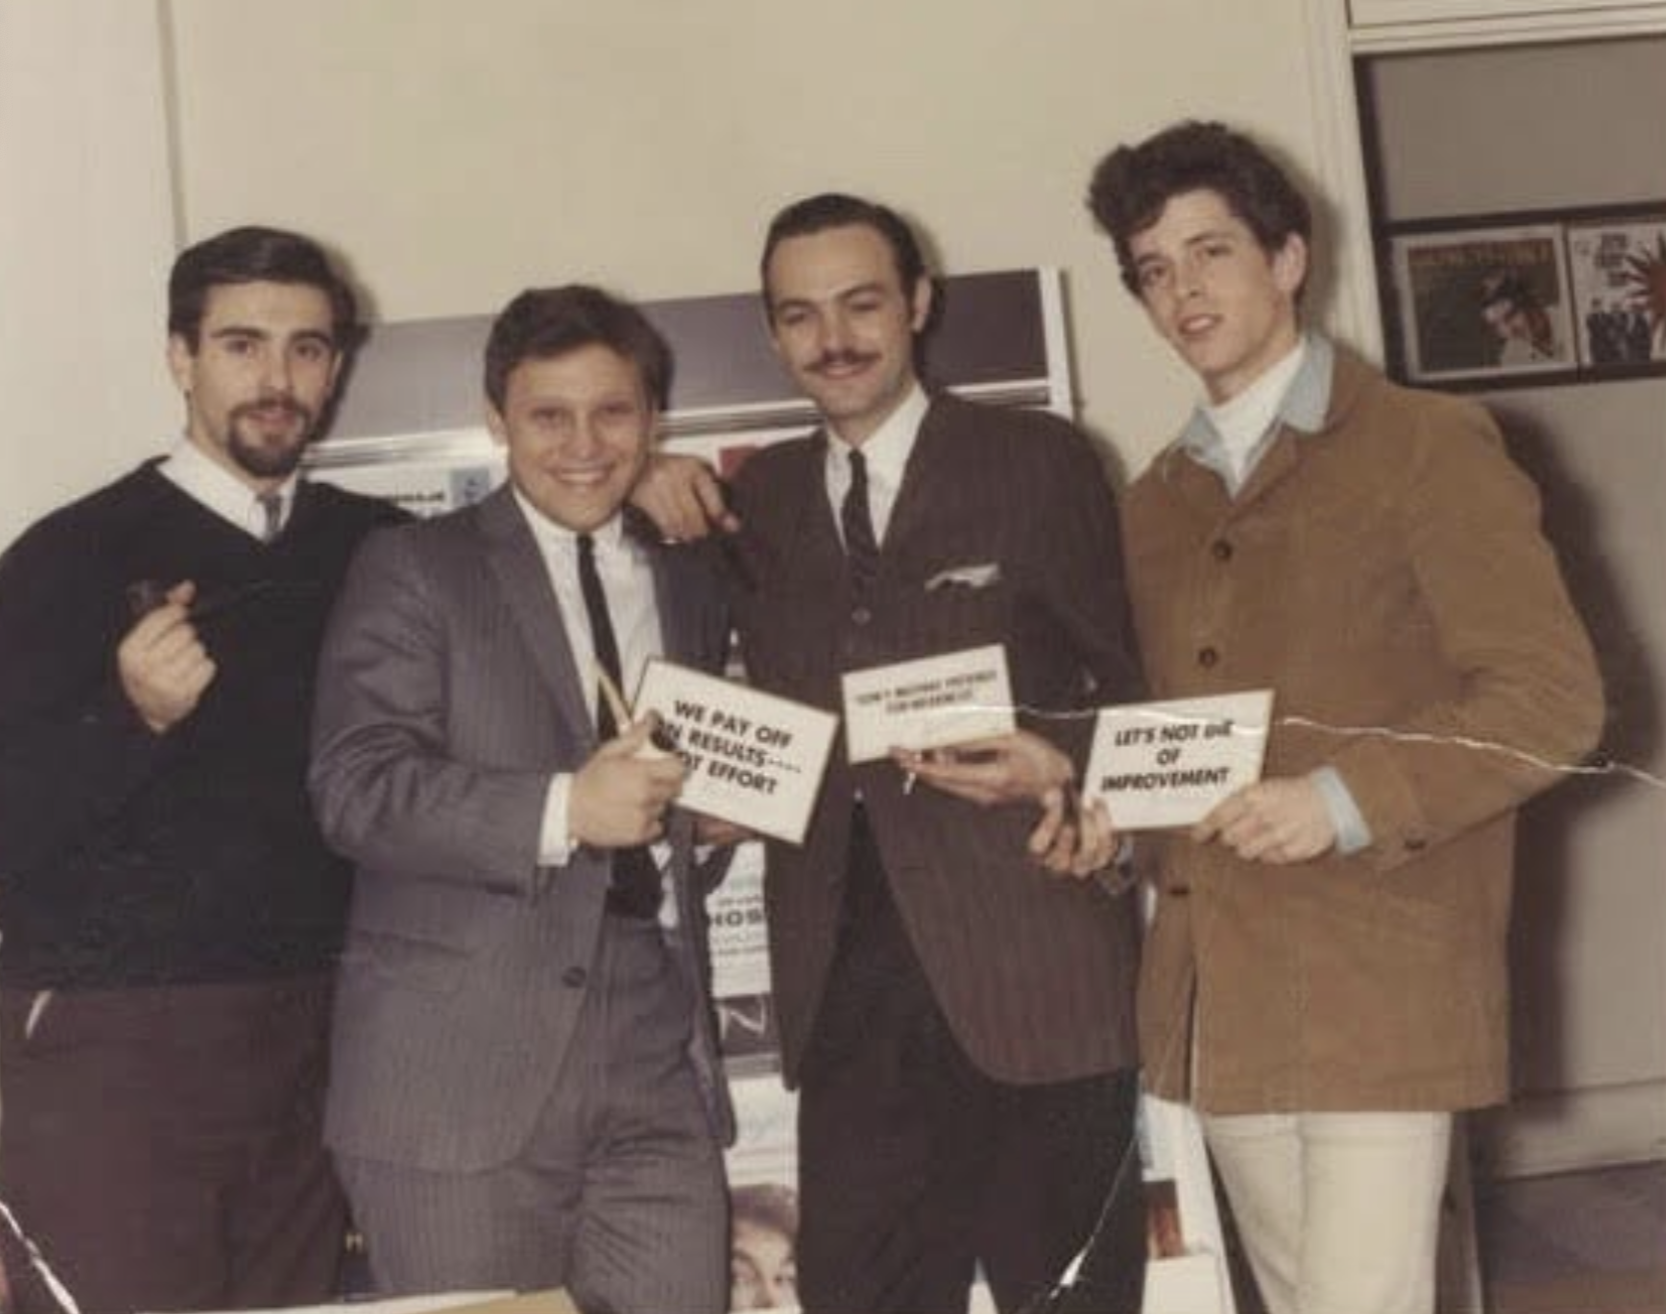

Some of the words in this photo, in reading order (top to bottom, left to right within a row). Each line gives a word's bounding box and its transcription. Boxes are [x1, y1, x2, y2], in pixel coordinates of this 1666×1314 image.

[674, 700, 706, 722] WE
[712, 711, 751, 735] PAY
[755, 725, 792, 747] OFF
[1115, 727, 1156, 746] LET'S
[1160, 723, 1201, 743] NOT
[1156, 747, 1182, 765] OF
[707, 760, 777, 795] EFFORT
[1101, 767, 1230, 792] IMPROVEMENT
